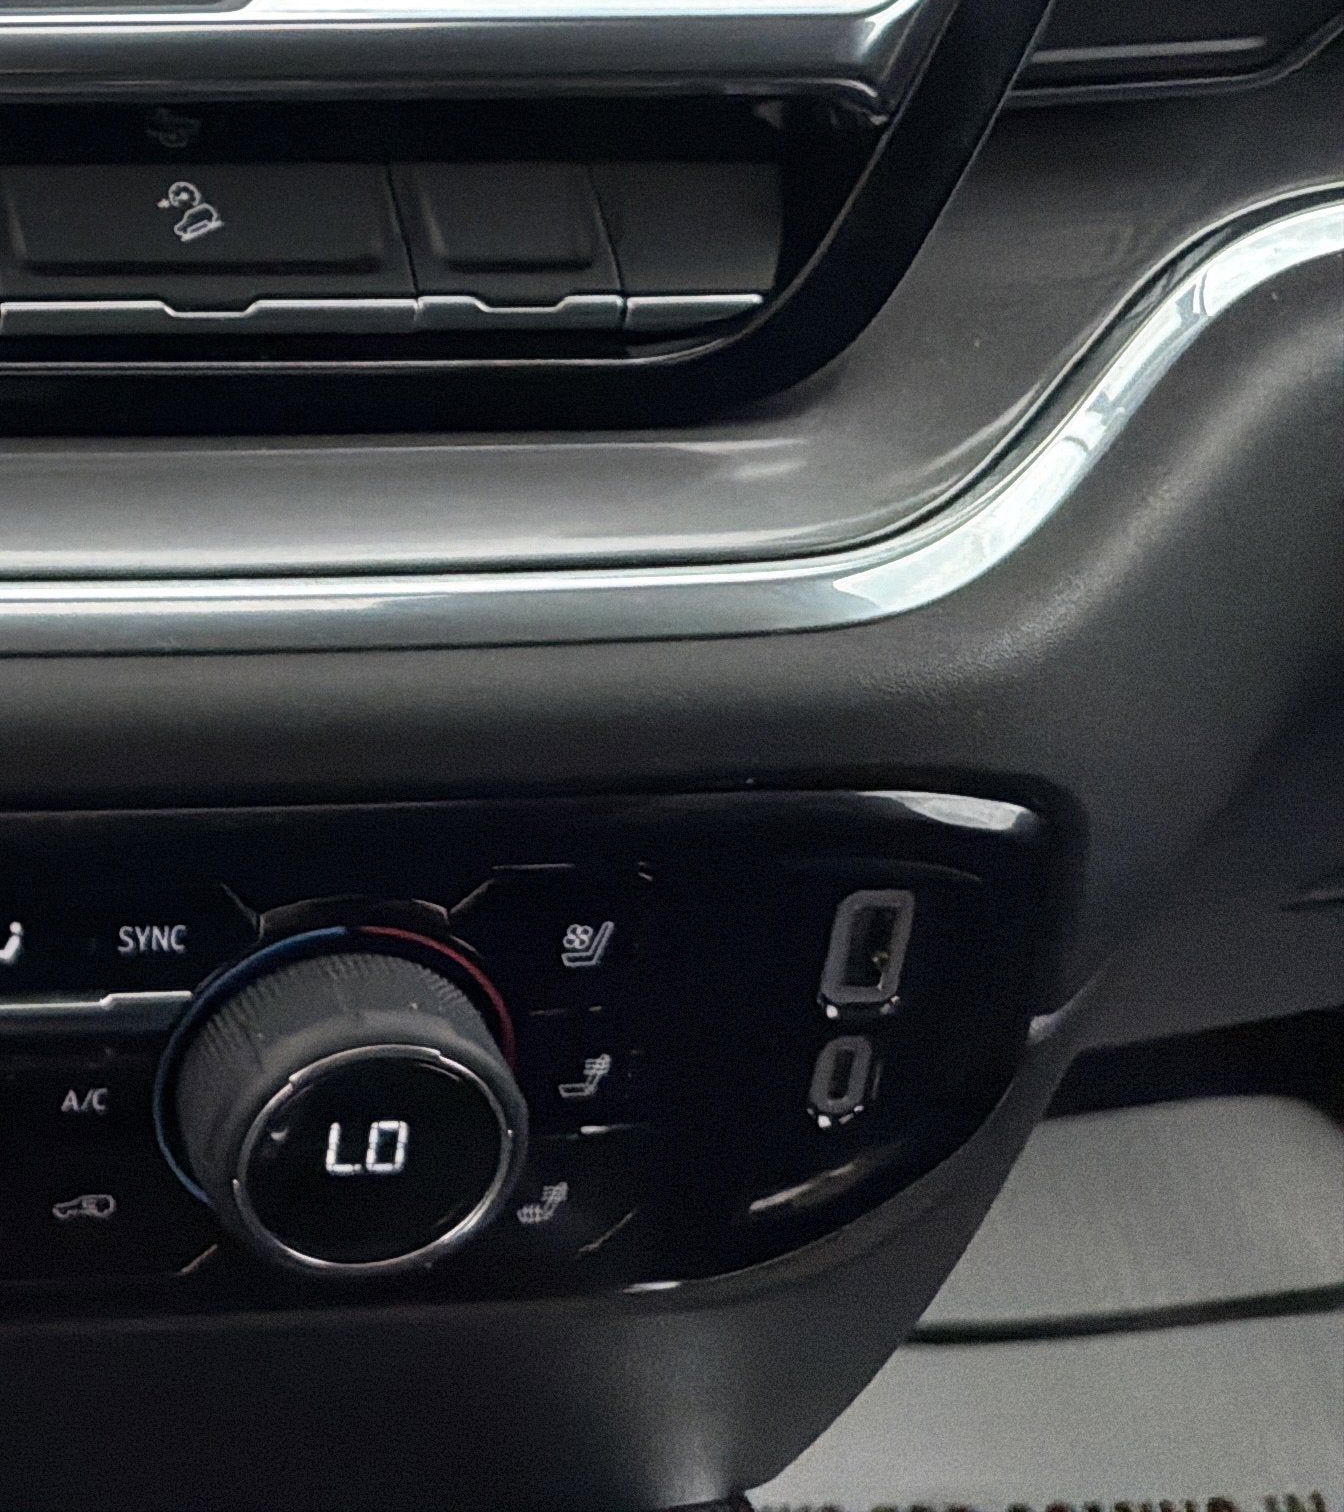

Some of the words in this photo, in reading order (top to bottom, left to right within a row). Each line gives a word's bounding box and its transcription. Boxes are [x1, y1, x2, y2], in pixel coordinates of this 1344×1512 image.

[116, 924, 188, 953] SYNC
[60, 1088, 109, 1113] A/C
[324, 1119, 409, 1175] LO
